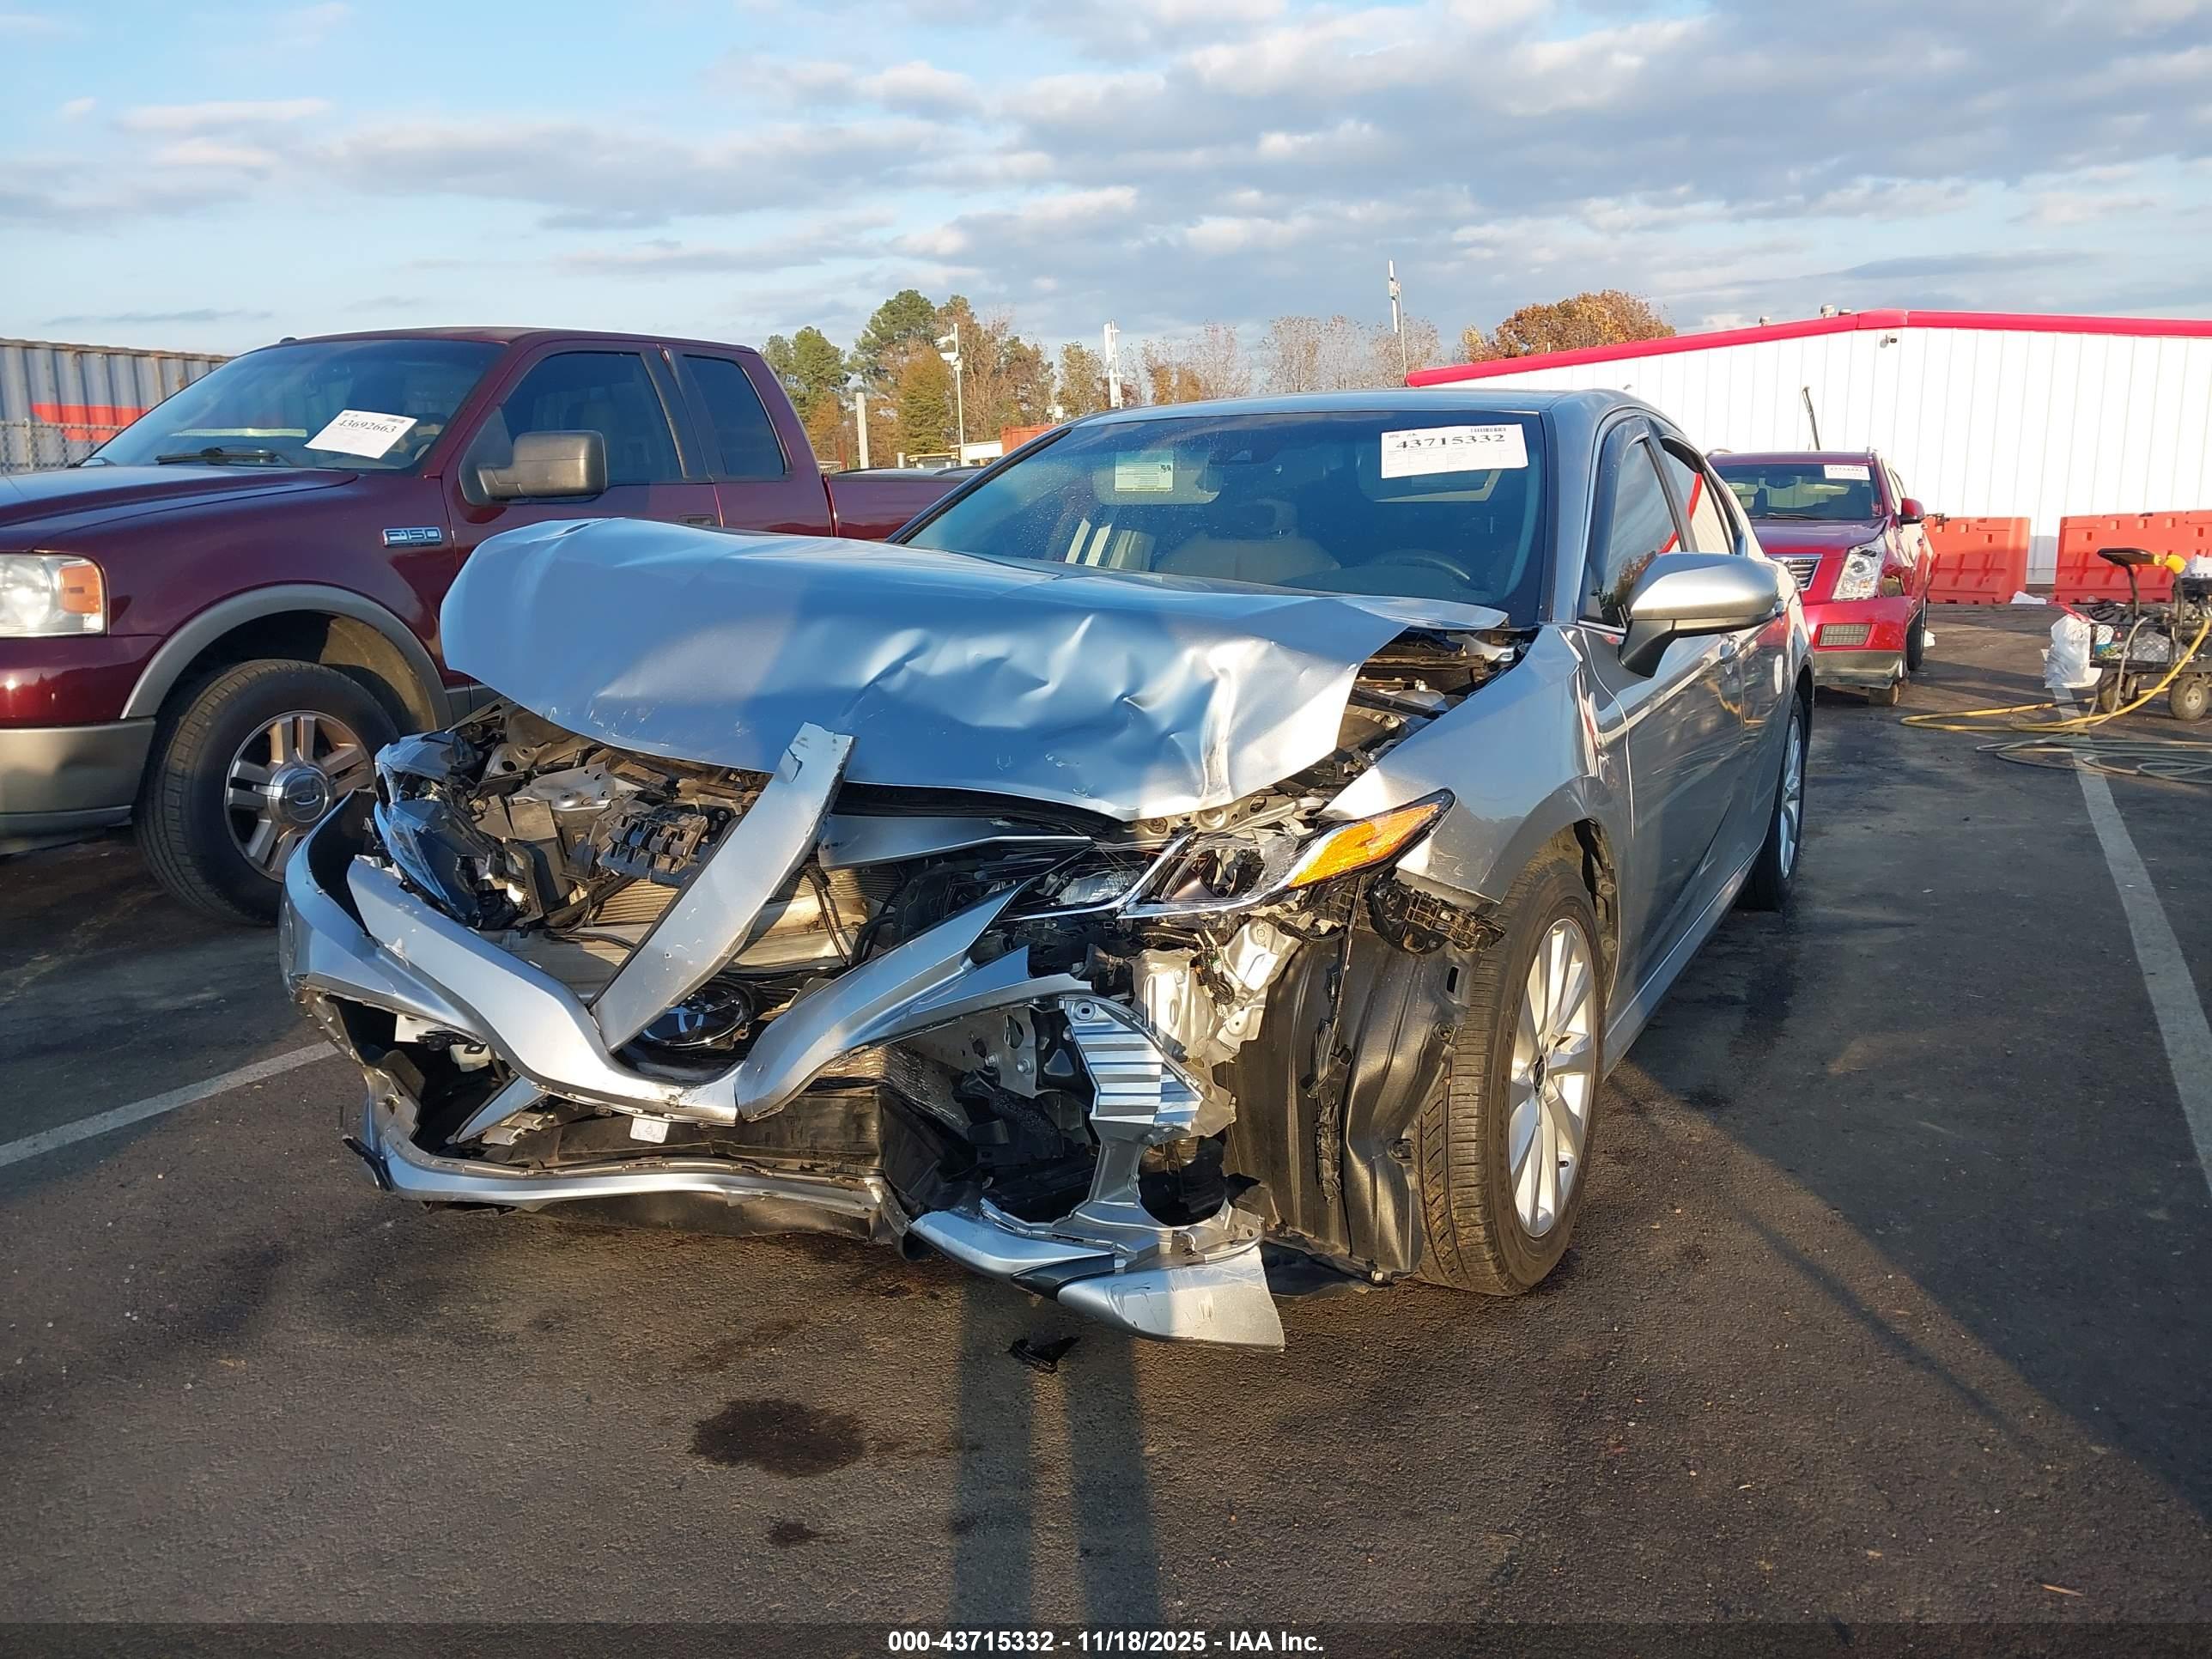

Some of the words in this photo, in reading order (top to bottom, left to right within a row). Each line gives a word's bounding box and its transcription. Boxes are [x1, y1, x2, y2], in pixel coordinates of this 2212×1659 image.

[337, 419, 397, 433] 43692663
[1395, 434, 1505, 448] 43715332
[385, 528, 441, 541] F-150
